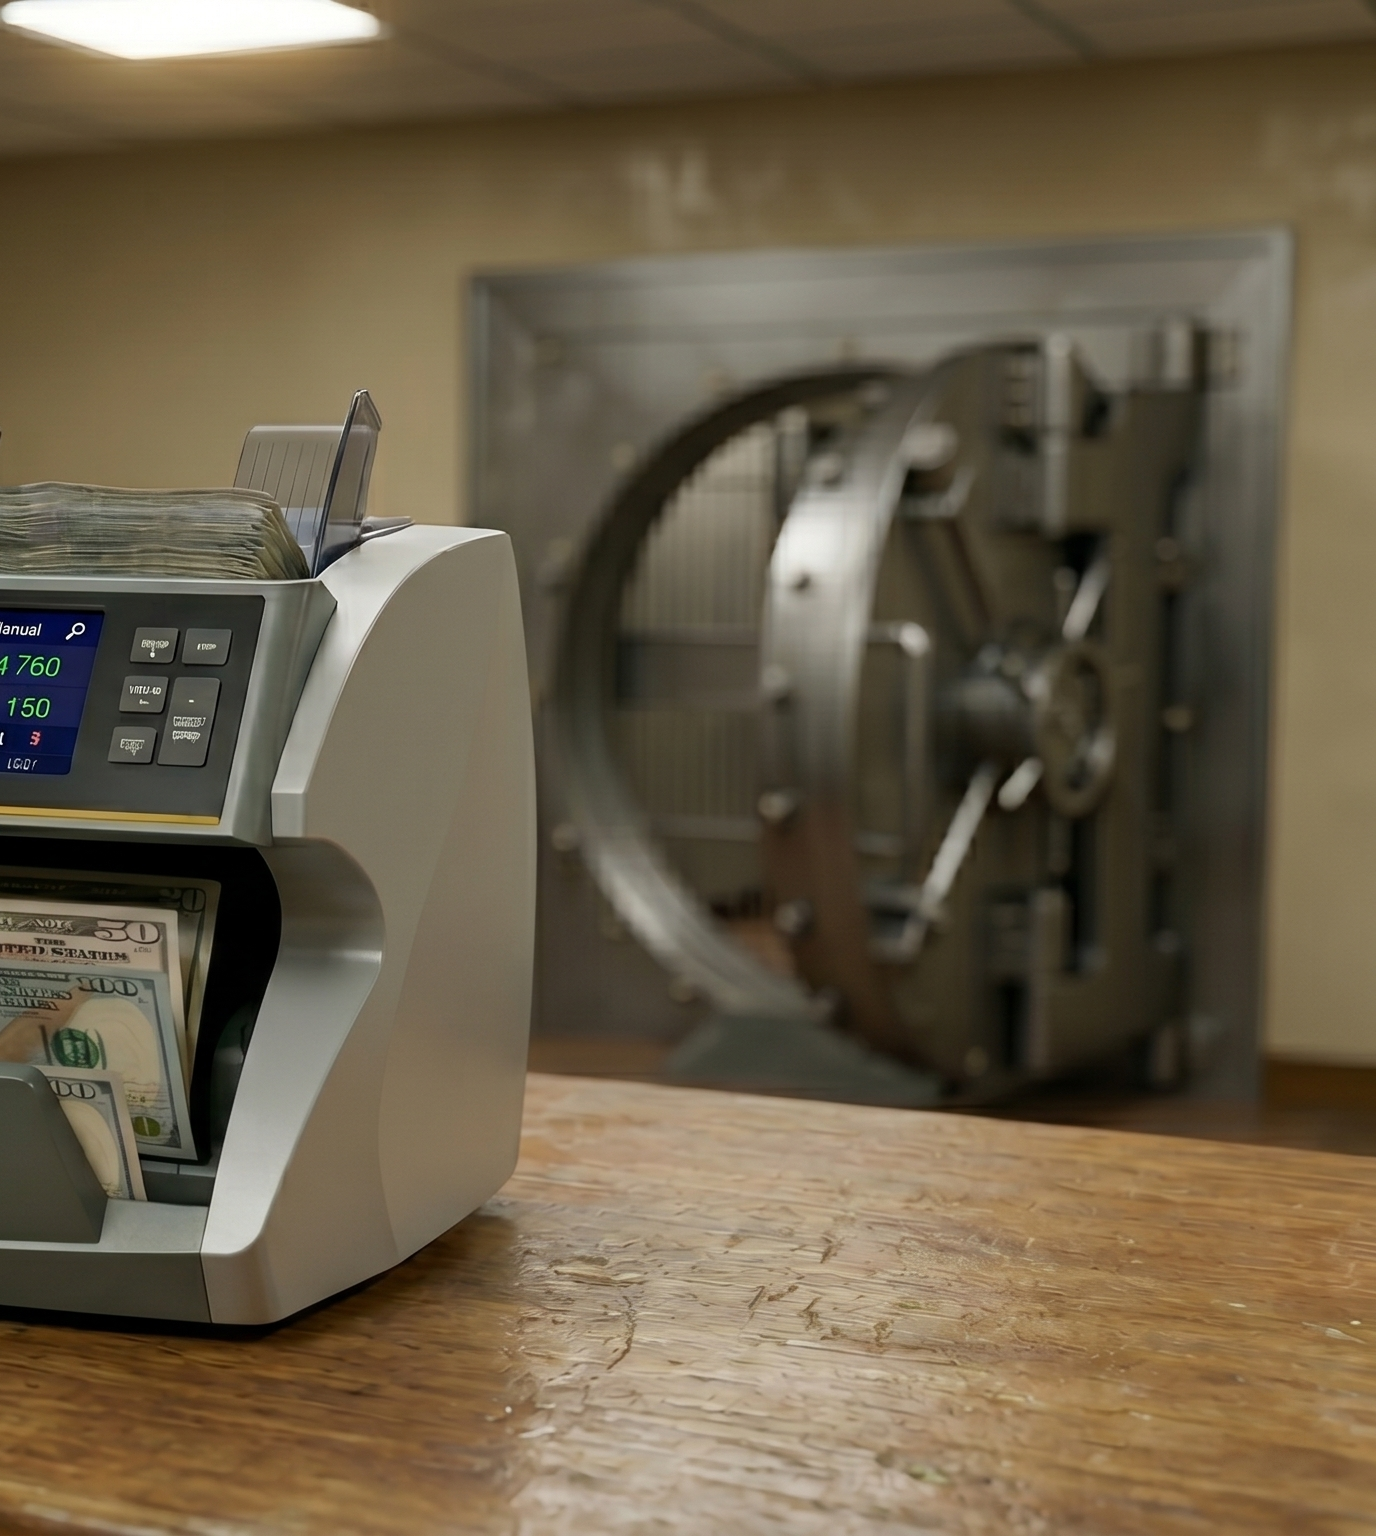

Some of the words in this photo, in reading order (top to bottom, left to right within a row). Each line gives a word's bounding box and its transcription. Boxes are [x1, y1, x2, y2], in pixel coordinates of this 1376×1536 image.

[7, 696, 51, 719] 150
[94, 919, 161, 944] 50
[75, 976, 139, 997] 100
